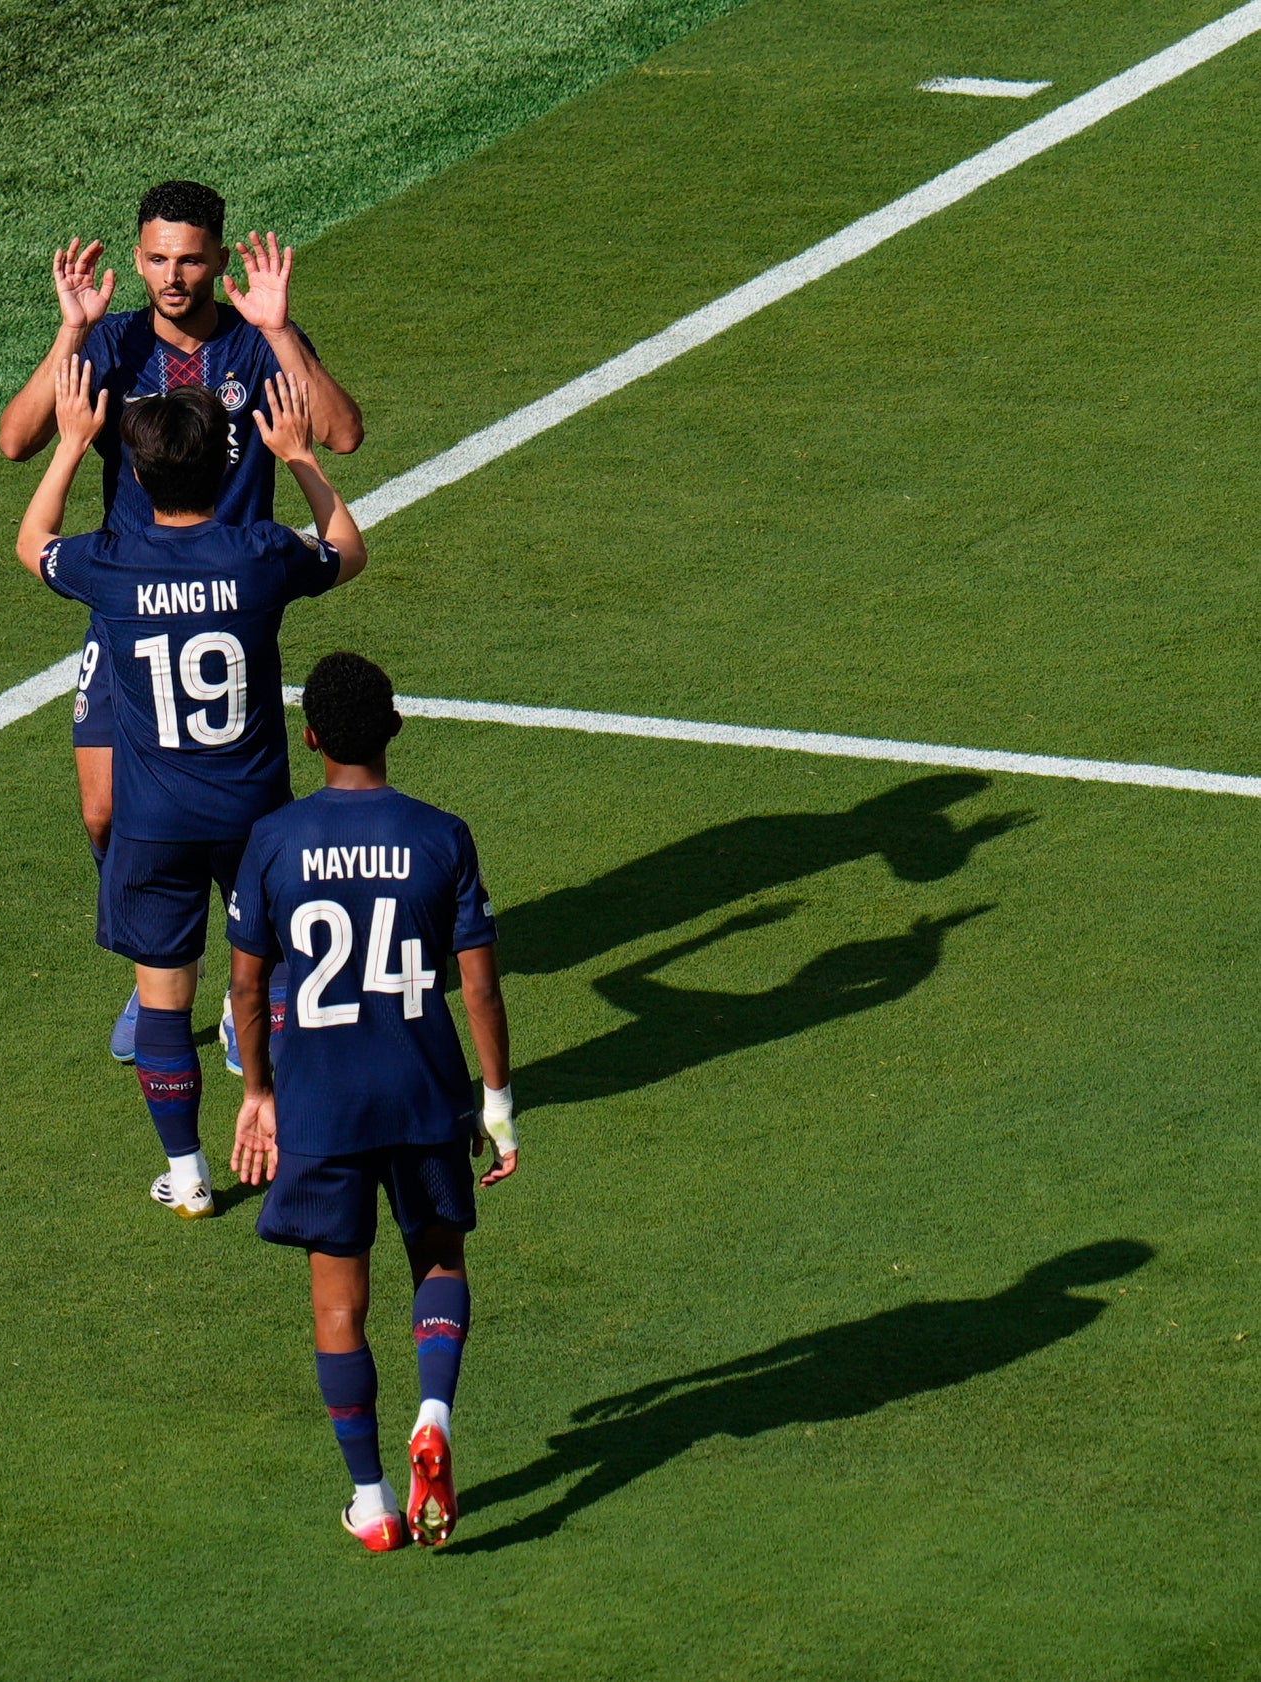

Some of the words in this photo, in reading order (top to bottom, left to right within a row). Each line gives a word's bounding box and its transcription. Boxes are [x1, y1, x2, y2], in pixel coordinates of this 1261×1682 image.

[220, 381, 240, 391] PARIS
[137, 581, 206, 615] KANG
[211, 580, 238, 612] IN
[79, 641, 99, 691] 9
[134, 631, 247, 748] 19
[302, 845, 411, 882] MAYULU
[290, 897, 436, 1029] 24
[150, 1081, 194, 1091] PARIS
